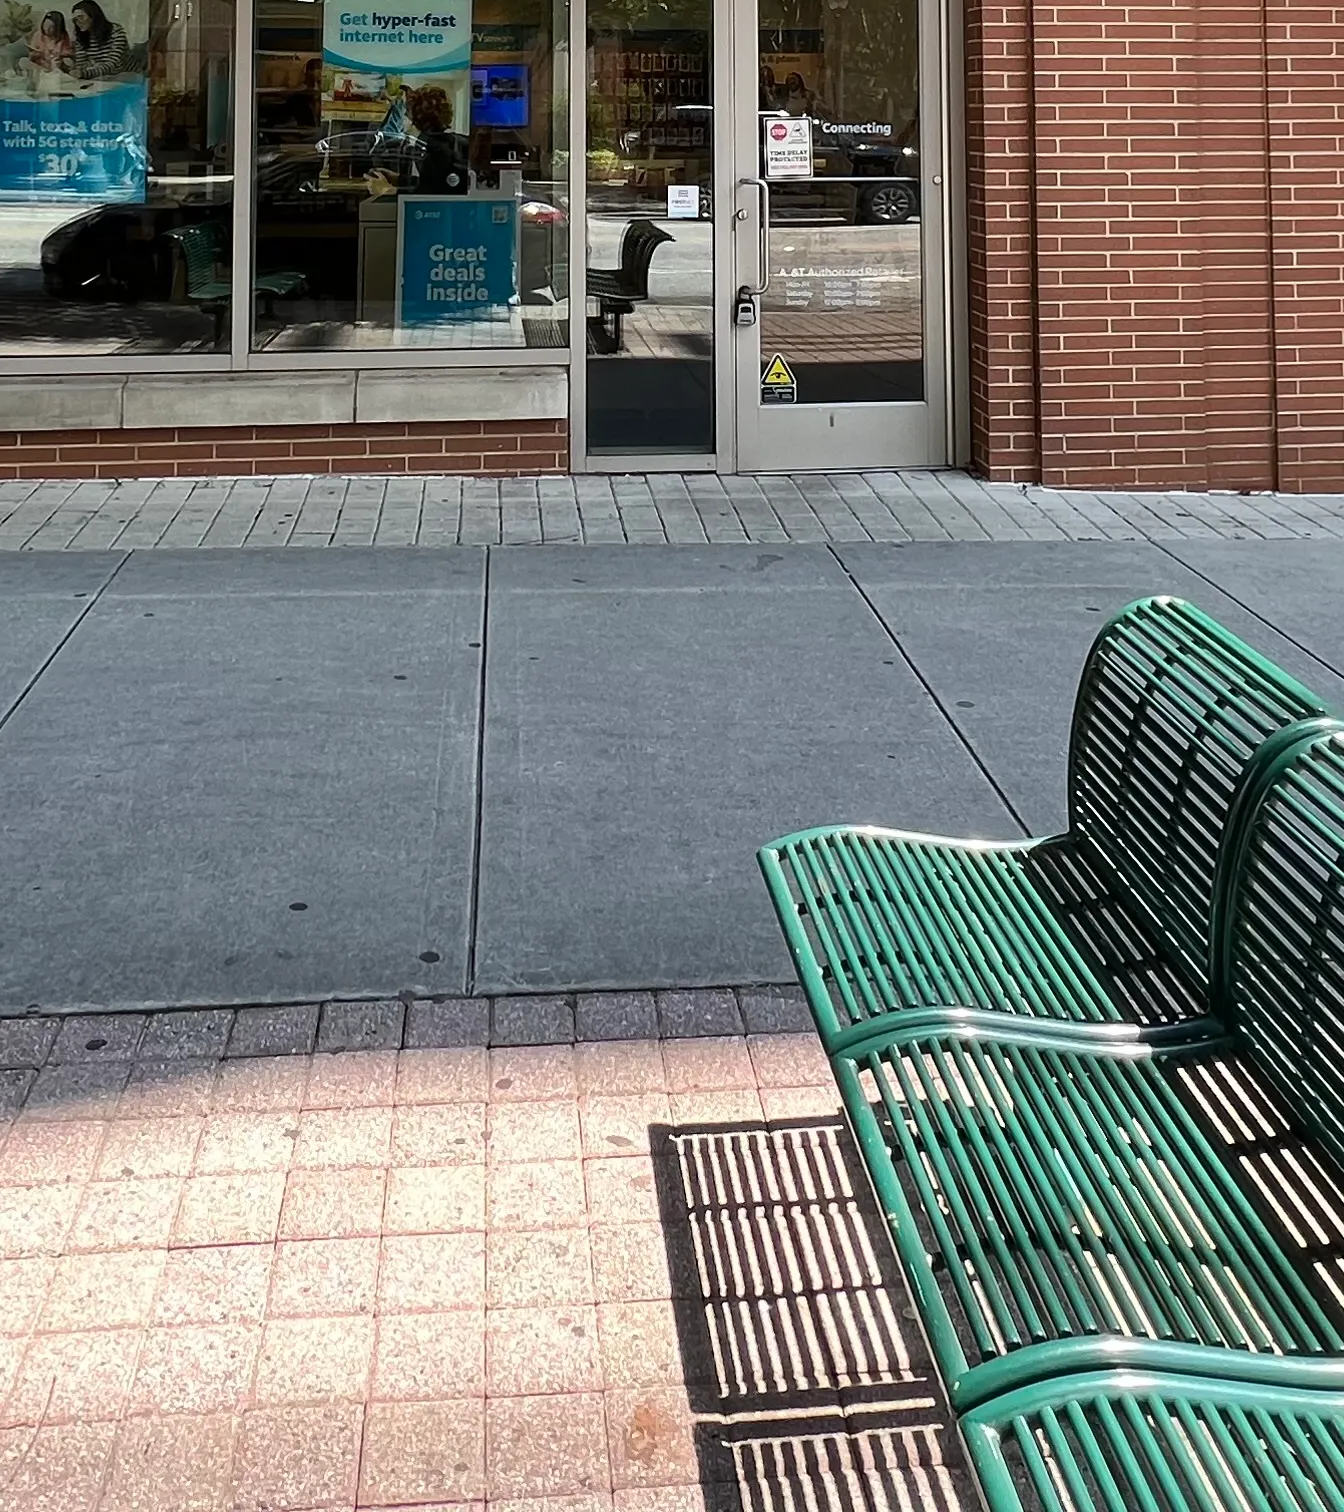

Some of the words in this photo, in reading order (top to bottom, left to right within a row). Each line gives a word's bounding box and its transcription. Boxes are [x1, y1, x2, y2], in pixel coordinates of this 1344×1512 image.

[340, 13, 368, 26] Get
[372, 12, 456, 29] hyper-fast
[339, 29, 404, 43] internet
[408, 30, 444, 43] here
[2, 120, 37, 135] Talk,
[91, 120, 124, 133] data
[771, 128, 786, 136] STOP
[822, 122, 892, 136] Connecting
[3, 135, 35, 148] with
[38, 136, 57, 148] 5G
[59, 135, 118, 151] starting
[428, 244, 487, 261] Great
[429, 263, 486, 281] deals
[778, 268, 806, 277] A&T
[807, 268, 864, 277] Authorized
[426, 283, 489, 302] inside
